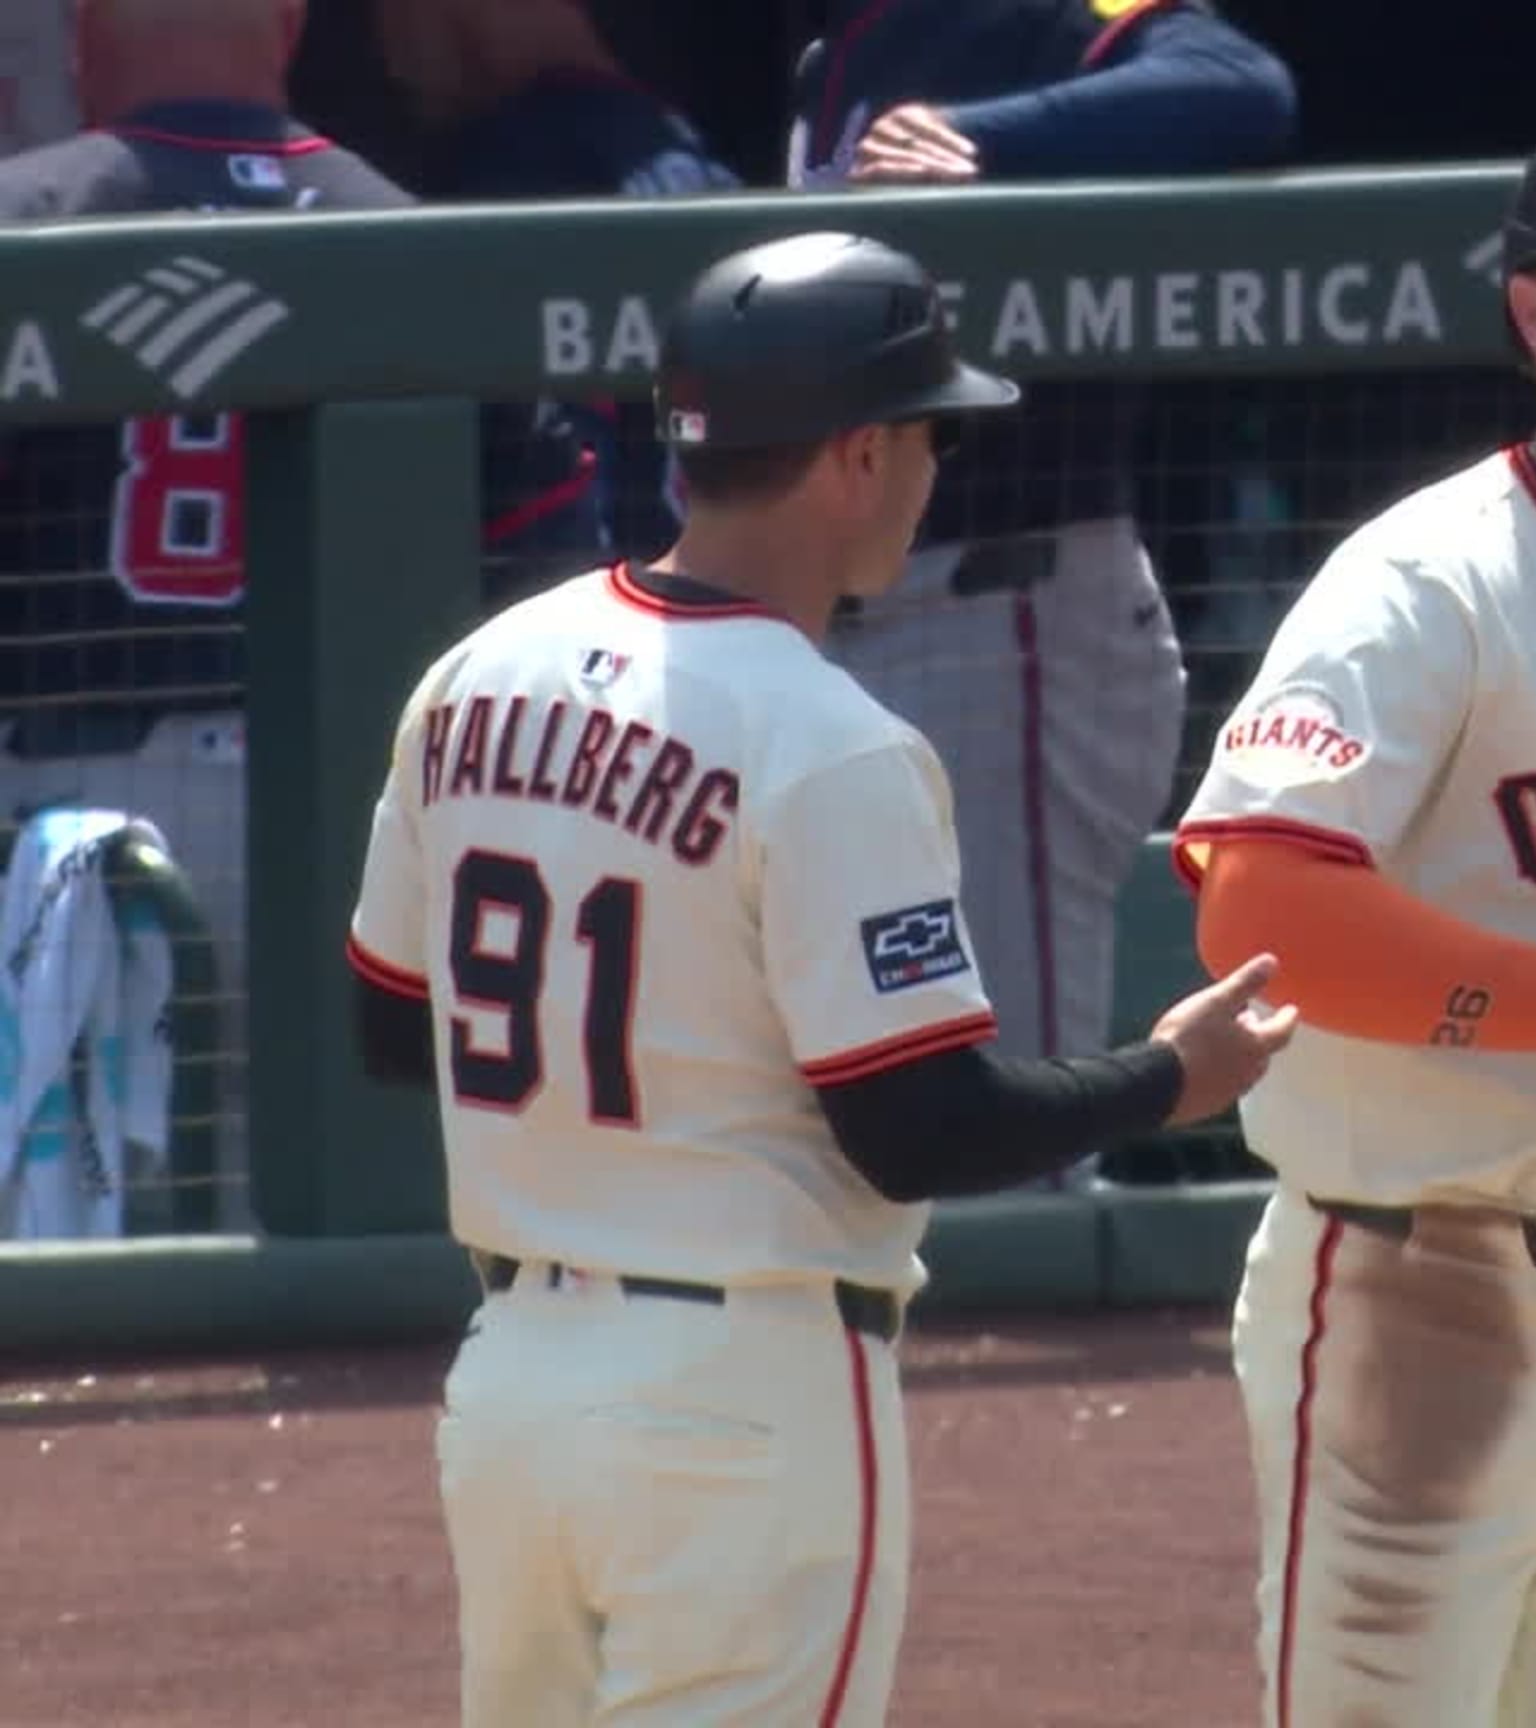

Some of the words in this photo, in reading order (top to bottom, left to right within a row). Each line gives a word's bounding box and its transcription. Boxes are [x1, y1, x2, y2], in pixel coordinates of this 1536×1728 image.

[541, 299, 661, 375] BA
[991, 266, 1443, 356] AMERICA
[420, 696, 741, 867] HALLBERG
[1225, 715, 1364, 768] GIANTS
[449, 845, 643, 1129] 91
